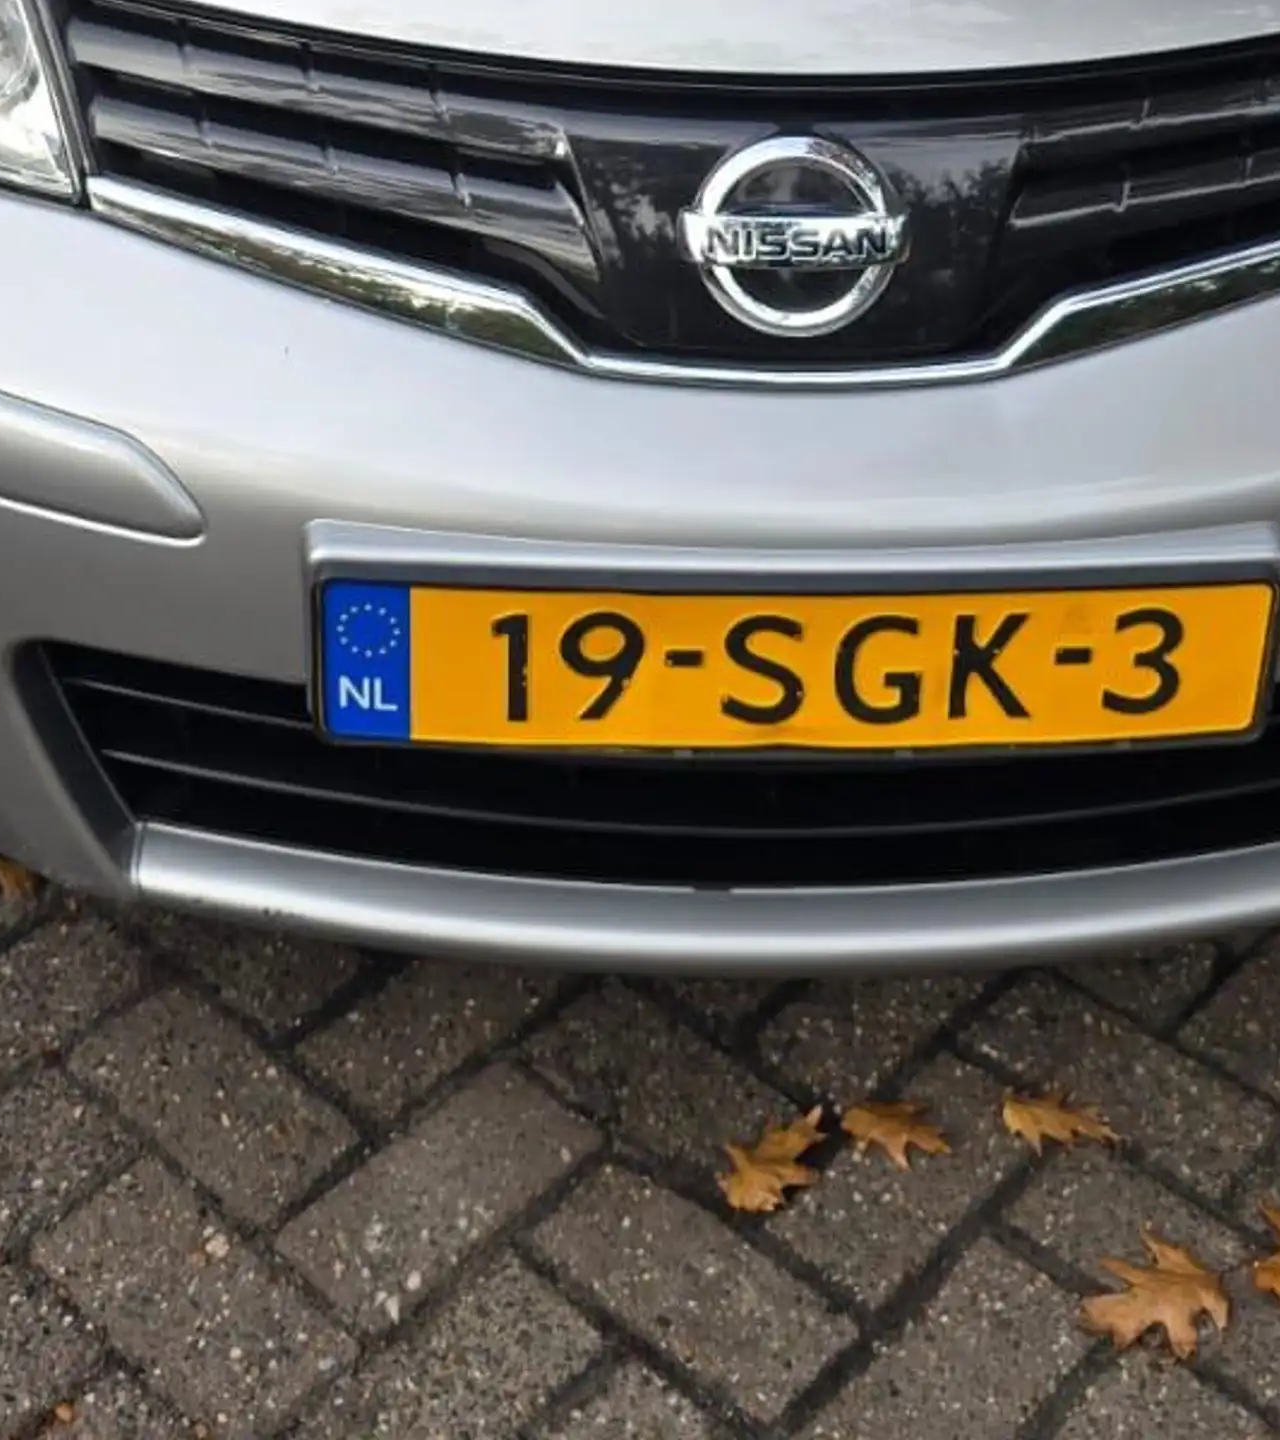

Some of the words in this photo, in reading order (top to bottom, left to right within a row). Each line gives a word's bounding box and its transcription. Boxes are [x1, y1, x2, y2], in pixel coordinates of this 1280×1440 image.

[707, 226, 888, 257] NISSAN
[491, 607, 1184, 725] 19-SGK-3
[338, 675, 399, 712] NL
